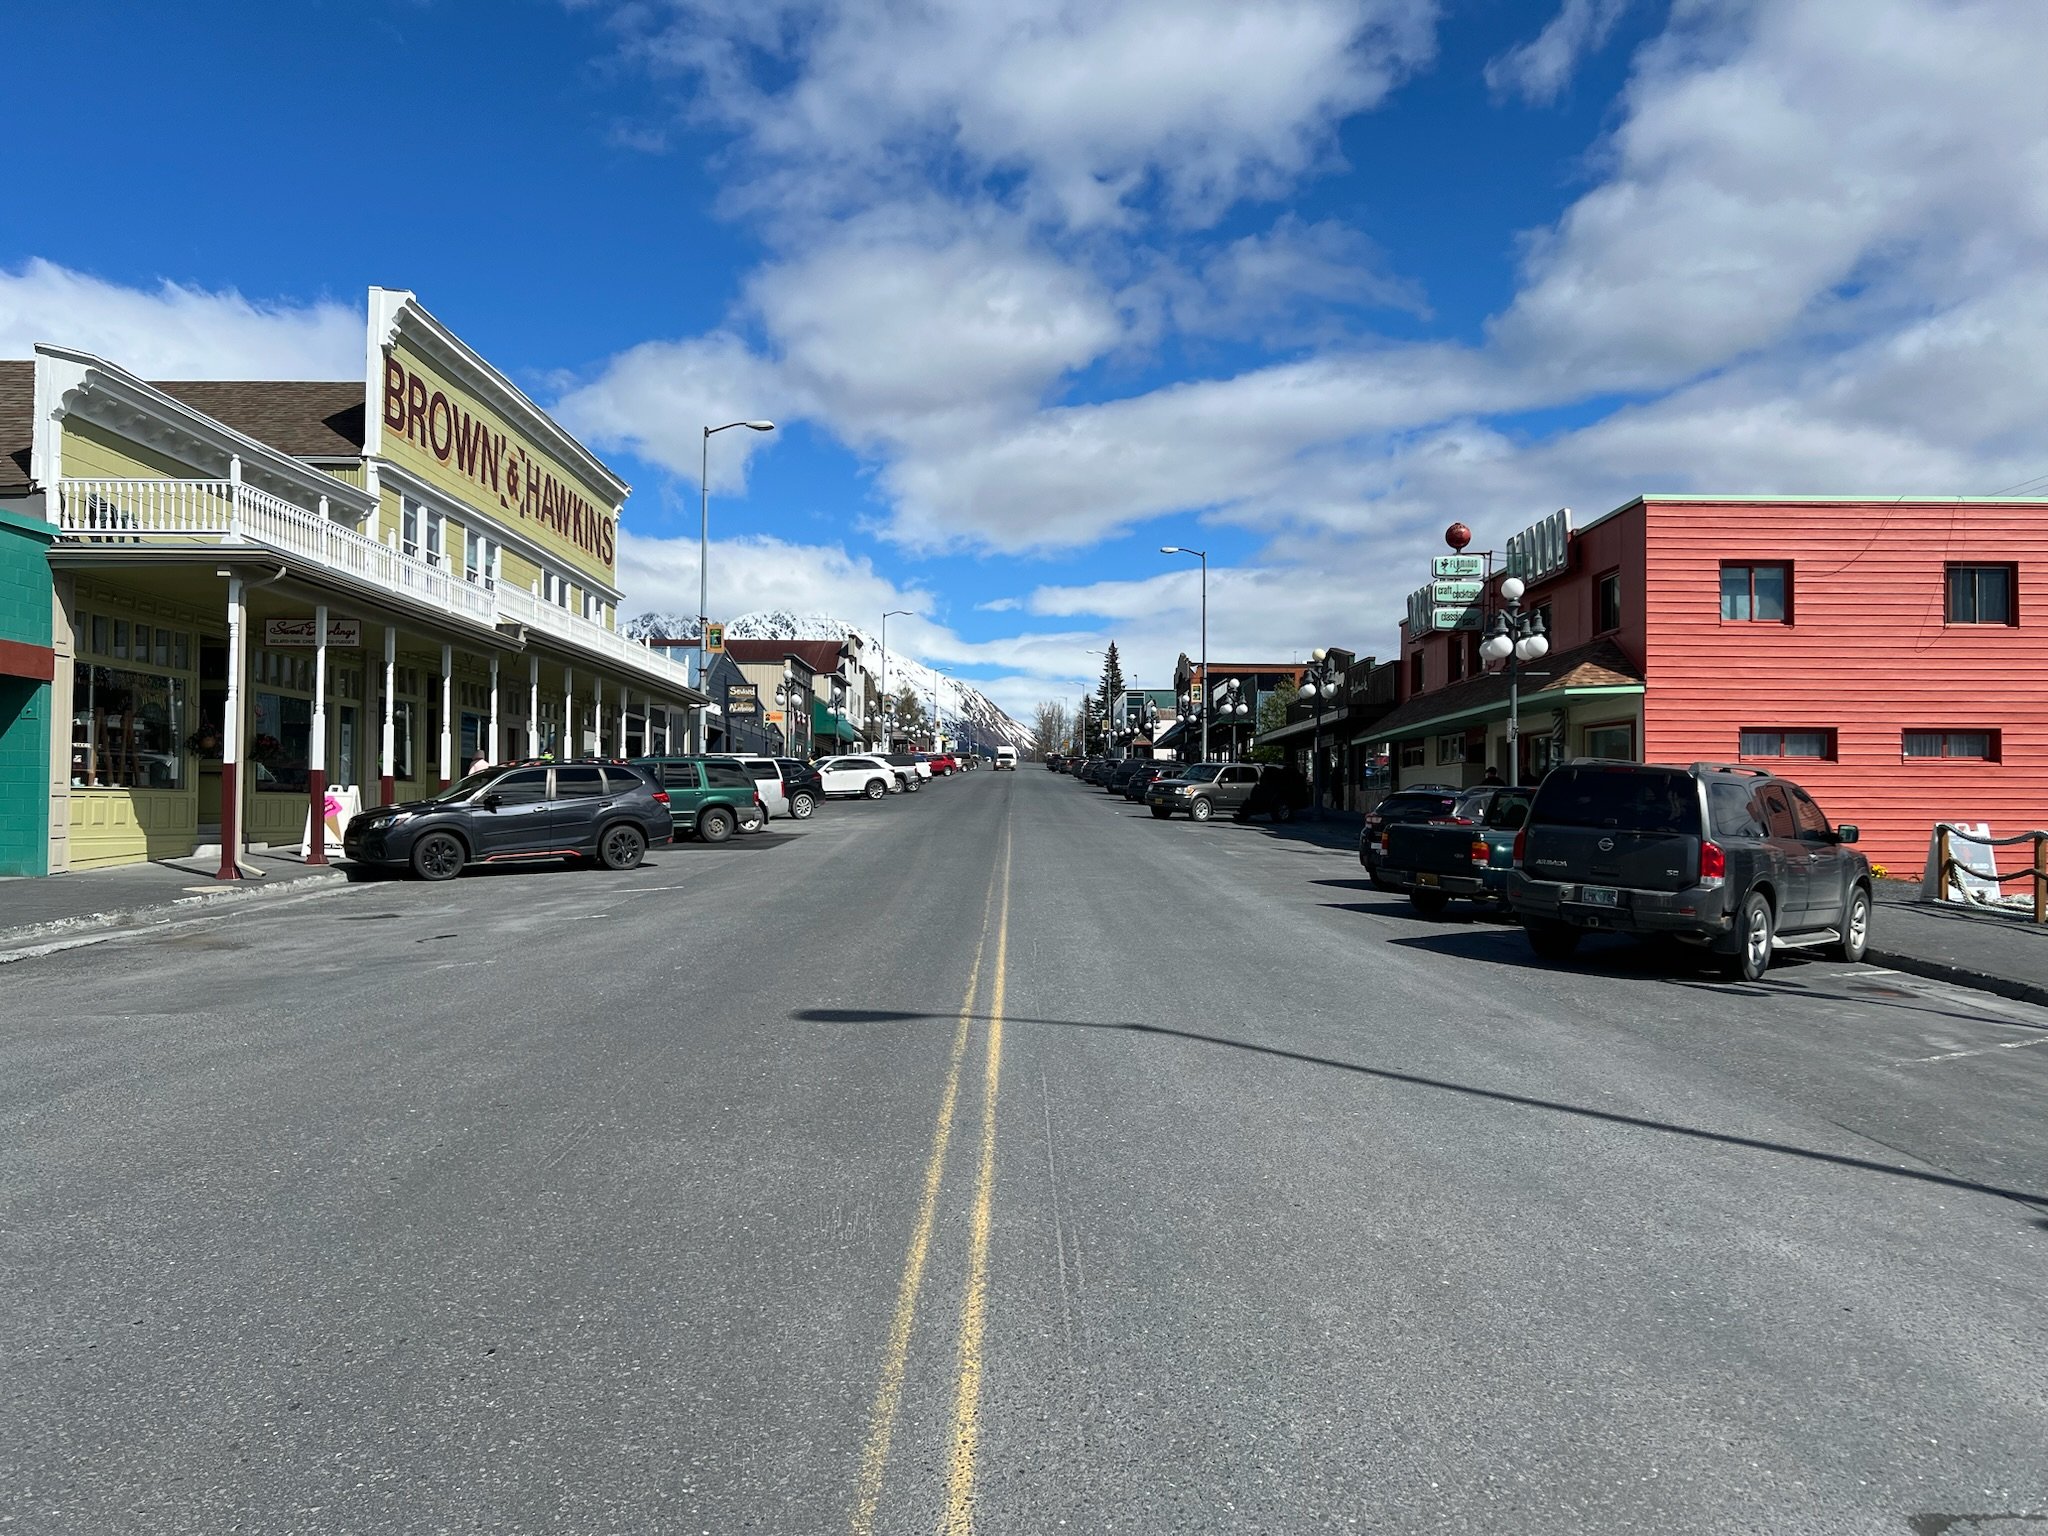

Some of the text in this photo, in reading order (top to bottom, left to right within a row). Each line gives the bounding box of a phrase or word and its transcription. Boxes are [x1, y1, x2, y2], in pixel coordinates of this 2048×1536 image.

[384, 356, 614, 567] BROWN & HAWKINS
[1450, 560, 1478, 568] FLAMINGO
[1437, 585, 1479, 599] craft cocktails
[1441, 612, 1463, 622] classic
[270, 621, 304, 635] Sweet
[1535, 858, 1568, 868] ARMADA
